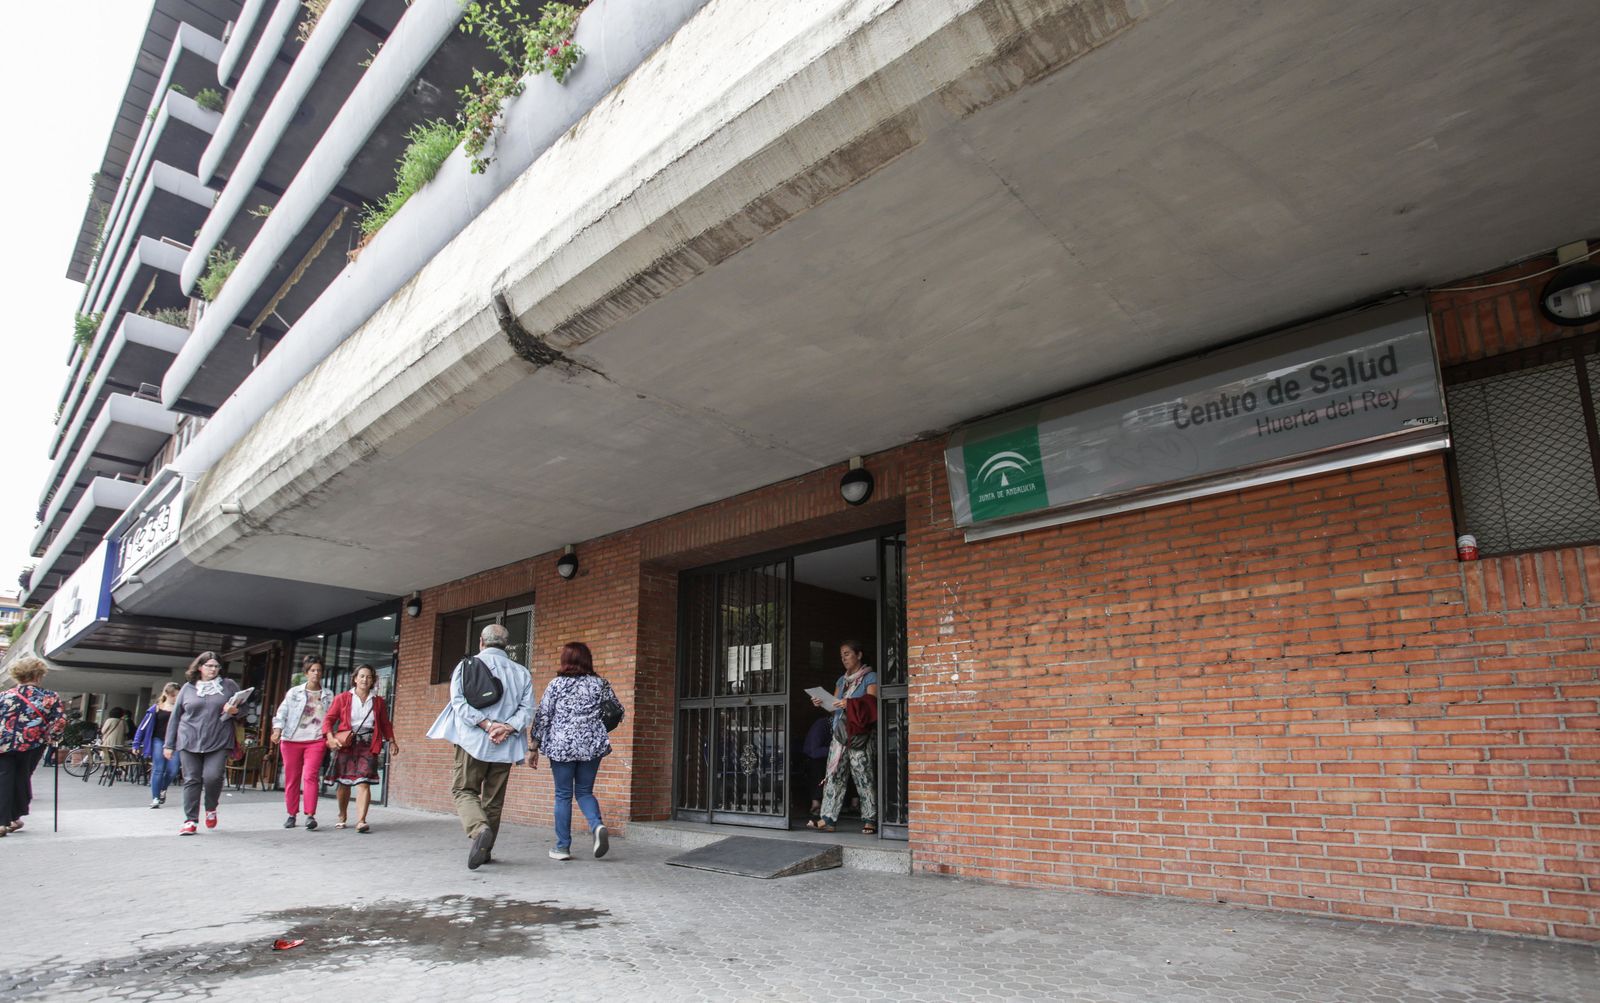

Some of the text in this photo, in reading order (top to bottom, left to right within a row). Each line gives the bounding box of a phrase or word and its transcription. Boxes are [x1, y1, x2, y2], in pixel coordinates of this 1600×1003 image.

[1172, 345, 1398, 430] Centro de Salud
[1255, 387, 1401, 437] Huerta del Rey
[978, 492, 995, 503] JUNTA
[996, 490, 1004, 499] DE
